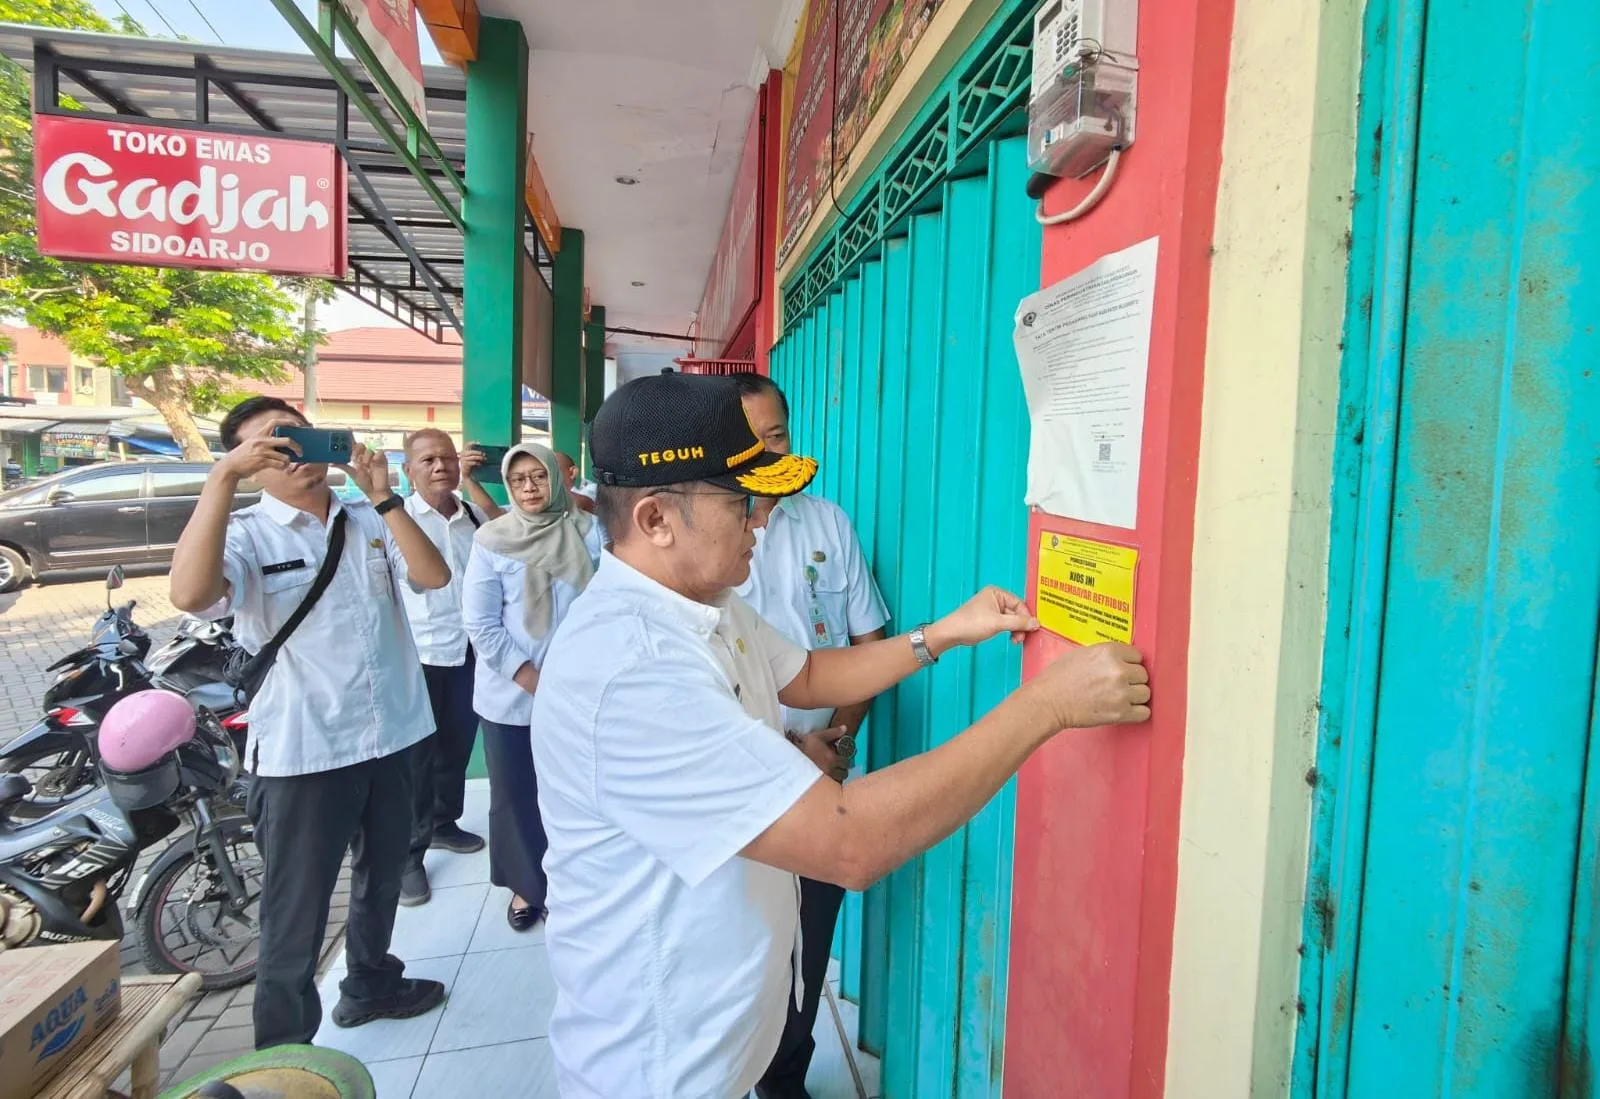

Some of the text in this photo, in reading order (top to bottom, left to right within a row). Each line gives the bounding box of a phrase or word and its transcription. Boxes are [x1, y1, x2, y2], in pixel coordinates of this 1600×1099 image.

[107, 129, 271, 164] TOKO EMAS
[42, 152, 329, 234] Gadjah
[111, 231, 270, 262] SIDOARJO
[638, 446, 704, 466] TEGUH
[1040, 576, 1059, 589] BELUM
[1059, 581, 1092, 601] MEMBAYAR
[1093, 591, 1130, 613] RETRIBUSI
[1069, 570, 1095, 587] KIOS INI
[30, 984, 88, 1051] AQUA
